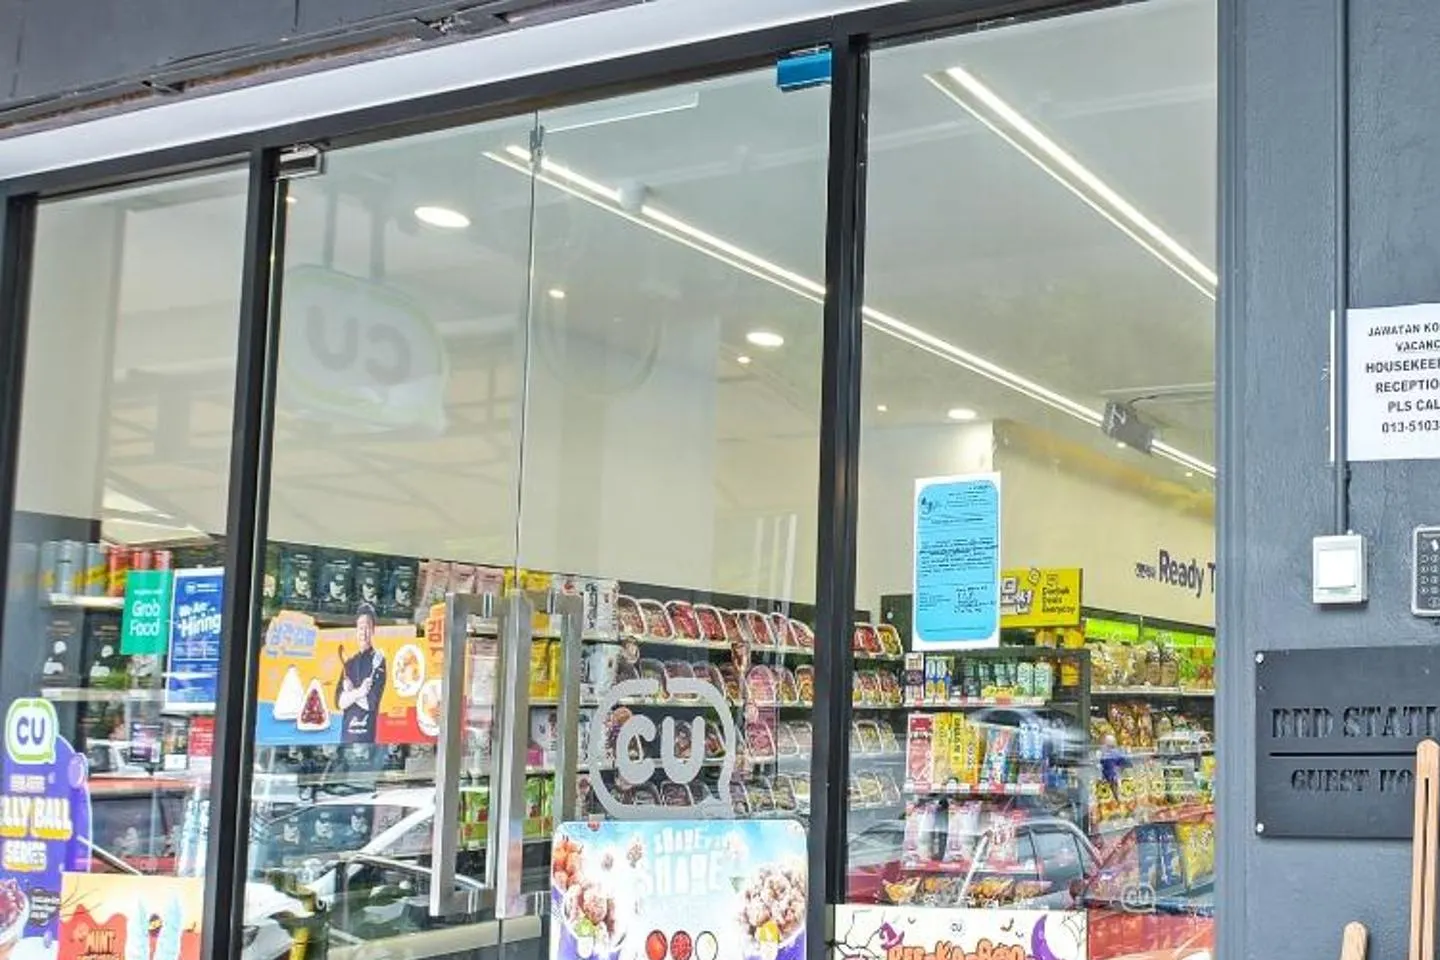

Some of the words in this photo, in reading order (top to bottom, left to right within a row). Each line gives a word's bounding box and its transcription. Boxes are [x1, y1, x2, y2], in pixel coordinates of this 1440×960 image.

[1368, 323, 1420, 337] JAWATAN
[1388, 400, 1412, 413] PLS
[1159, 549, 1205, 598] Ready
[132, 599, 161, 617] Grab
[130, 618, 161, 637] Food
[181, 613, 222, 638] Hiring
[16, 716, 45, 745] CU
[1271, 707, 1334, 738] BED
[616, 715, 705, 784] CU
[1291, 768, 1370, 792] GUEST
